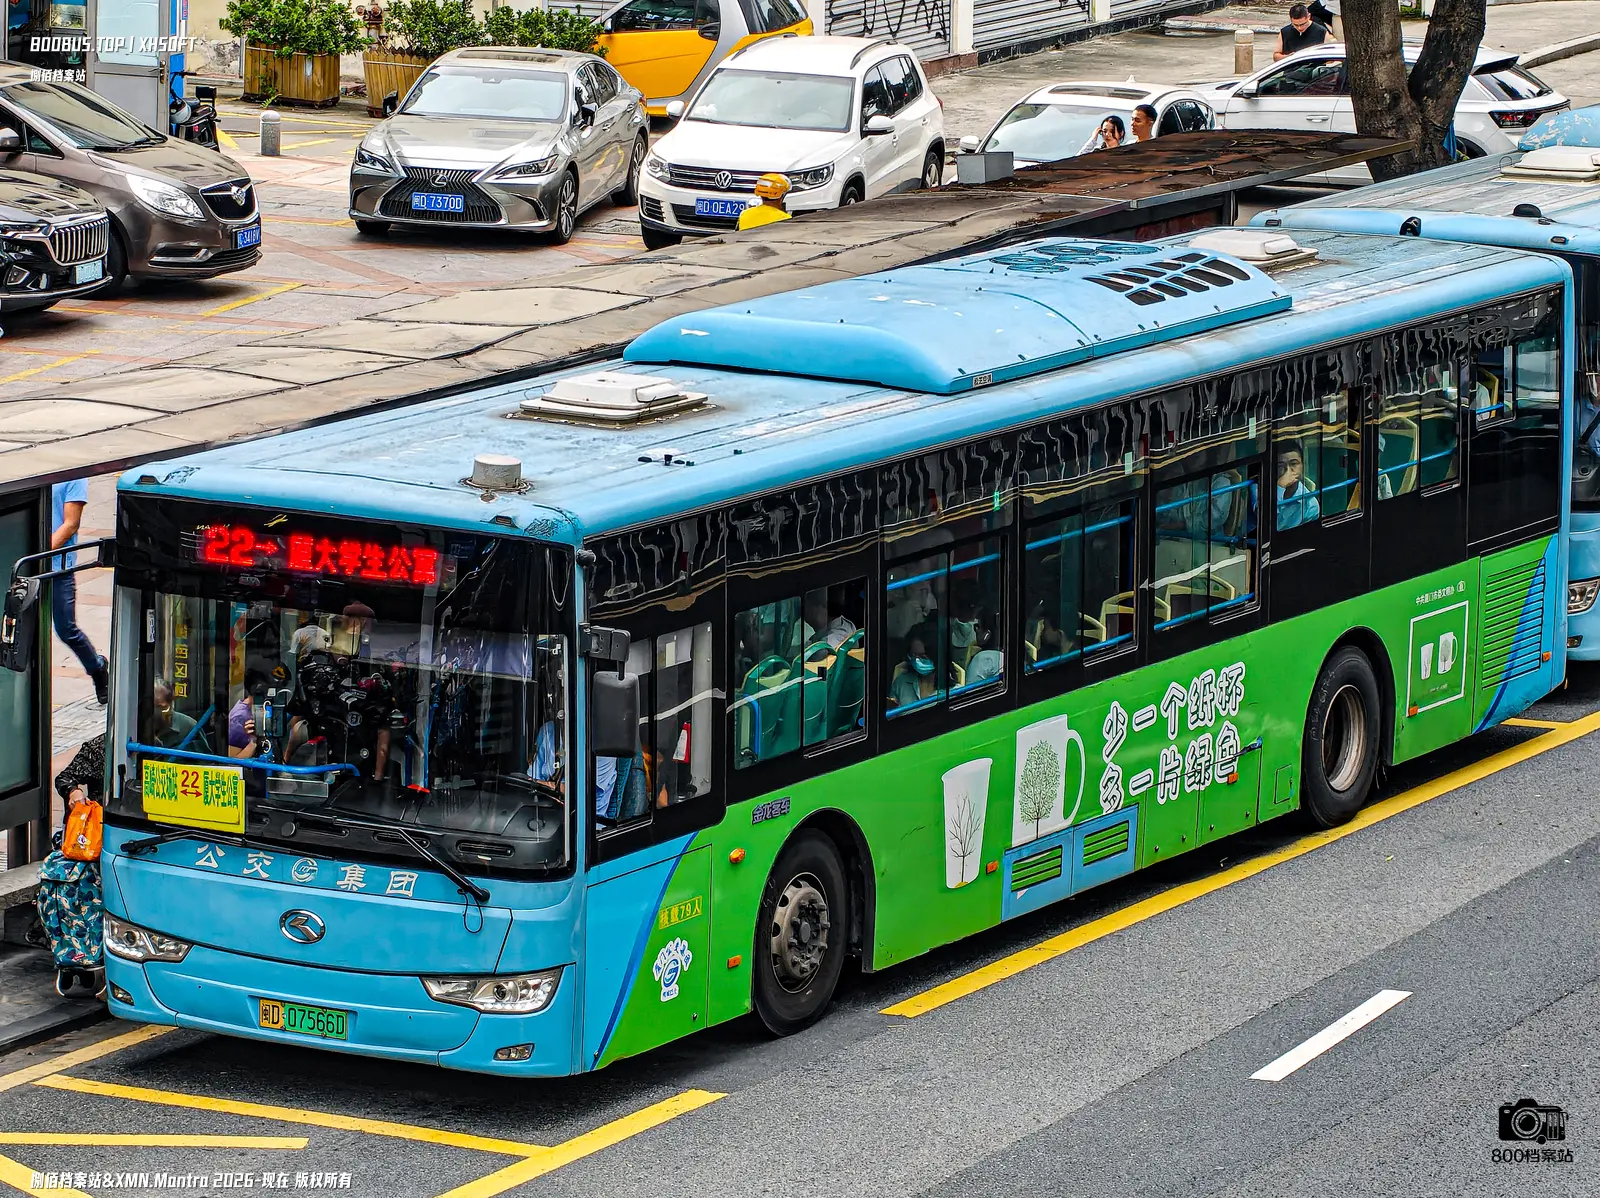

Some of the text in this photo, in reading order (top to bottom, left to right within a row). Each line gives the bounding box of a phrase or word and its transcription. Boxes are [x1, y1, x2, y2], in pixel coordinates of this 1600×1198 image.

[205, 526, 254, 566] 22
[1102, 661, 1246, 764] 少一个纸杯
[181, 770, 200, 789] 22
[1100, 720, 1241, 815] 多一片绿色
